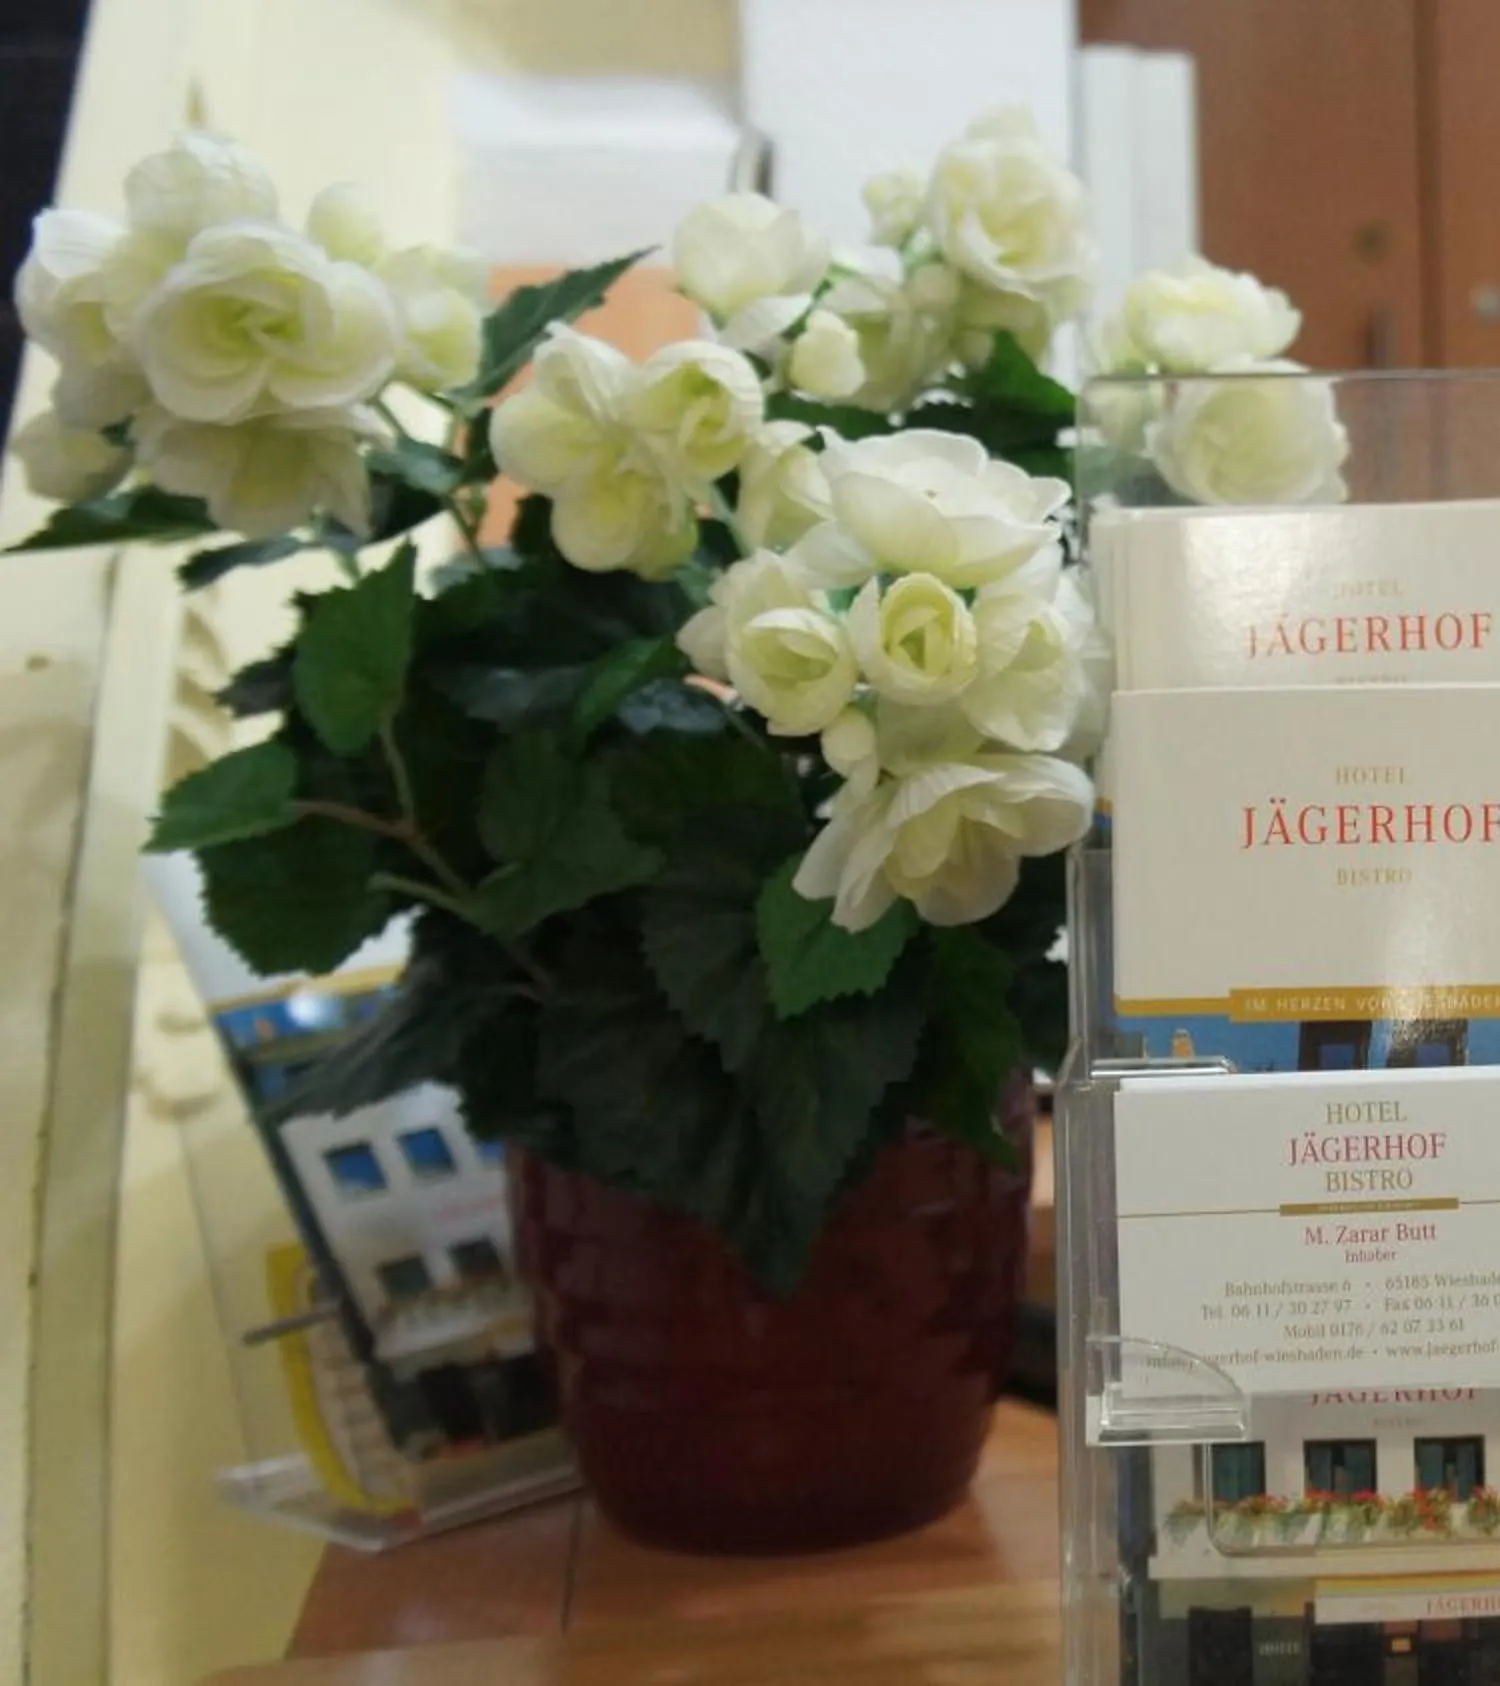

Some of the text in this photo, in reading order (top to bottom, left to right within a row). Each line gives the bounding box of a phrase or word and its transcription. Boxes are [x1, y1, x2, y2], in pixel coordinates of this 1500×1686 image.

[1335, 766, 1408, 785] HOTEL
[1336, 867, 1413, 886] BISTRO
[1277, 993, 1346, 1012] HERZEN
[1326, 1101, 1408, 1125] HOTEL
[1288, 1131, 1448, 1167] JÄGERHOF
[1326, 1168, 1414, 1193] BISTRO
[1304, 1222, 1437, 1246] M. Zarar Butt
[1345, 1248, 1397, 1264] Inhaber
[1384, 1296, 1411, 1313] Fax
[1284, 1323, 1326, 1340] Mobil
